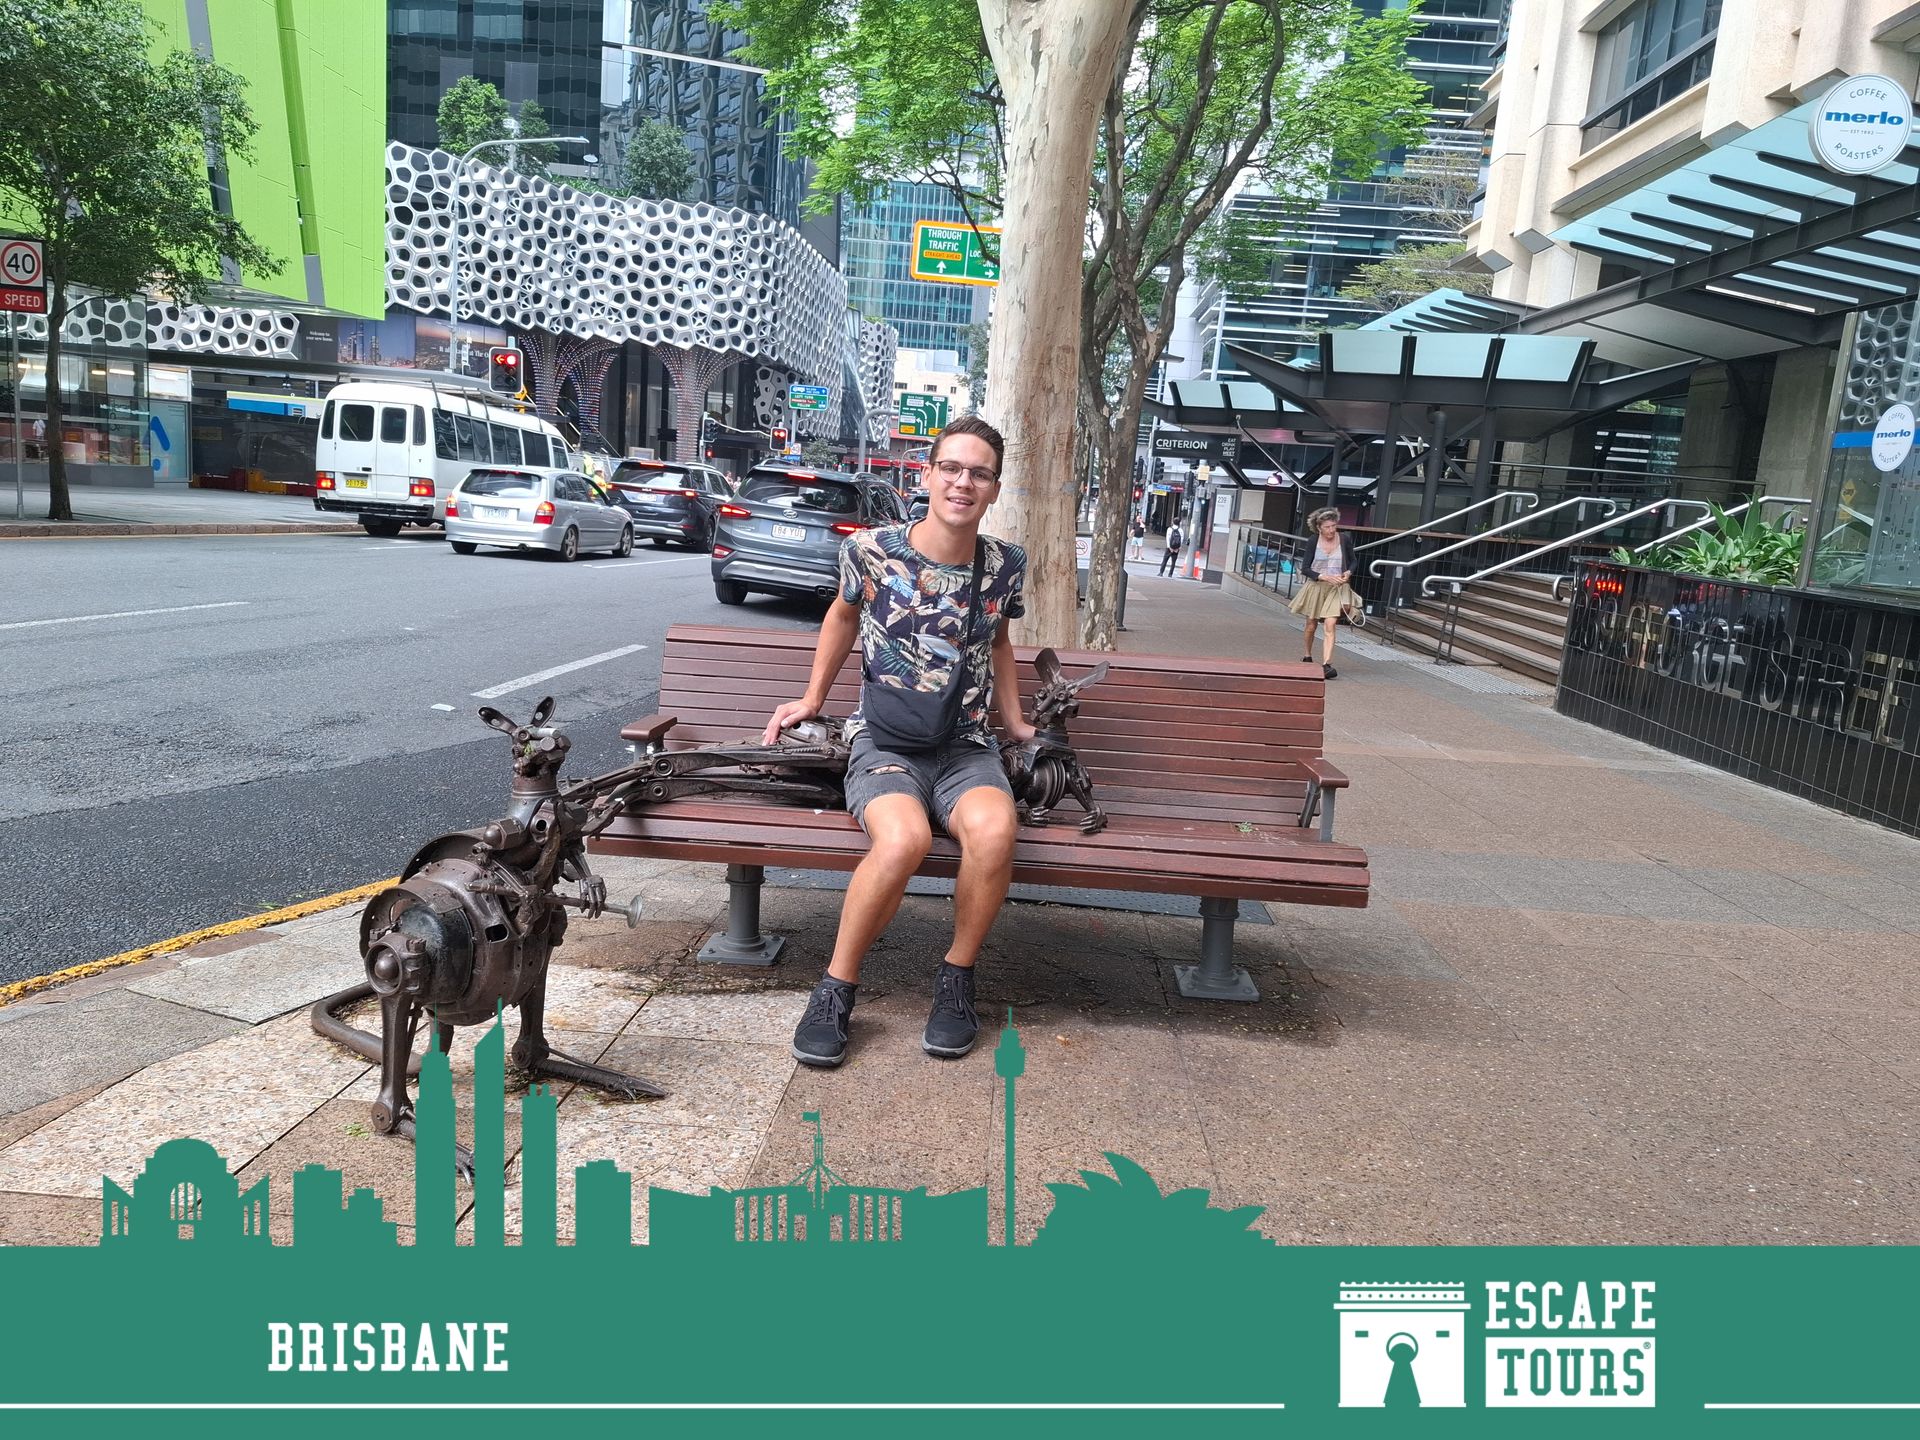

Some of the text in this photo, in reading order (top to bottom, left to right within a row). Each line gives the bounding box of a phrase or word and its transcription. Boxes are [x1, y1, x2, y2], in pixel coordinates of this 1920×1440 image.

[1849, 88, 1887, 101] COFFEE
[1825, 111, 1904, 126] merlo
[1834, 142, 1884, 160] ROASTERS
[928, 228, 962, 241] THROUGH
[928, 240, 959, 252] TRAFFIC
[6, 252, 36, 274] 40
[4, 293, 41, 308] SPEED
[1876, 429, 1911, 439] merlo
[1156, 439, 1208, 450] CRITERION
[1622, 602, 1746, 700] GEORGE
